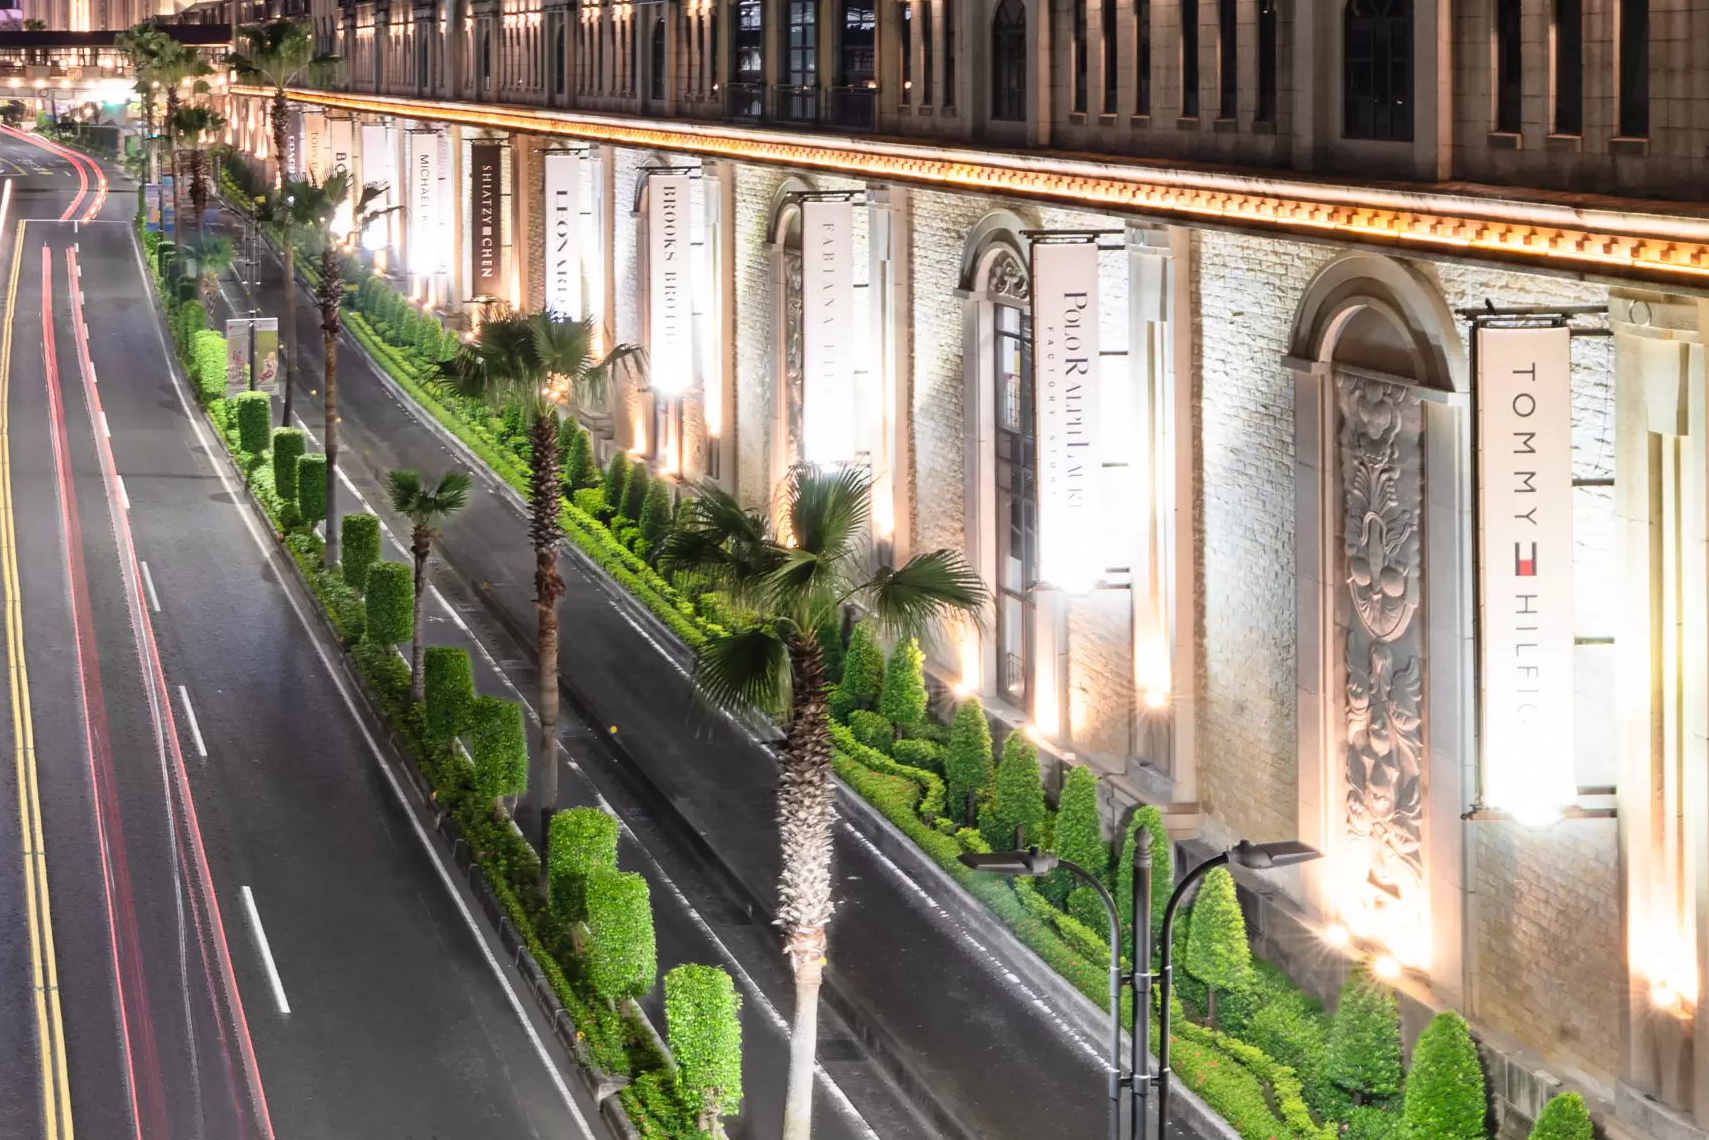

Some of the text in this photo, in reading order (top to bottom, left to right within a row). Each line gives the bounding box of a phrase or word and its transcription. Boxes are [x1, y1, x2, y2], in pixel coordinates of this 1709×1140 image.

[481, 166, 492, 277] SHIATZY CHEN
[557, 190, 567, 304] LEONARD
[663, 186, 675, 260] BROOKS
[823, 223, 834, 324] FABIANA
[1063, 292, 1088, 350] POLO
[1047, 326, 1055, 416] FACTORY
[1065, 357, 1089, 435] RALPH
[1512, 363, 1537, 525] TOMMY
